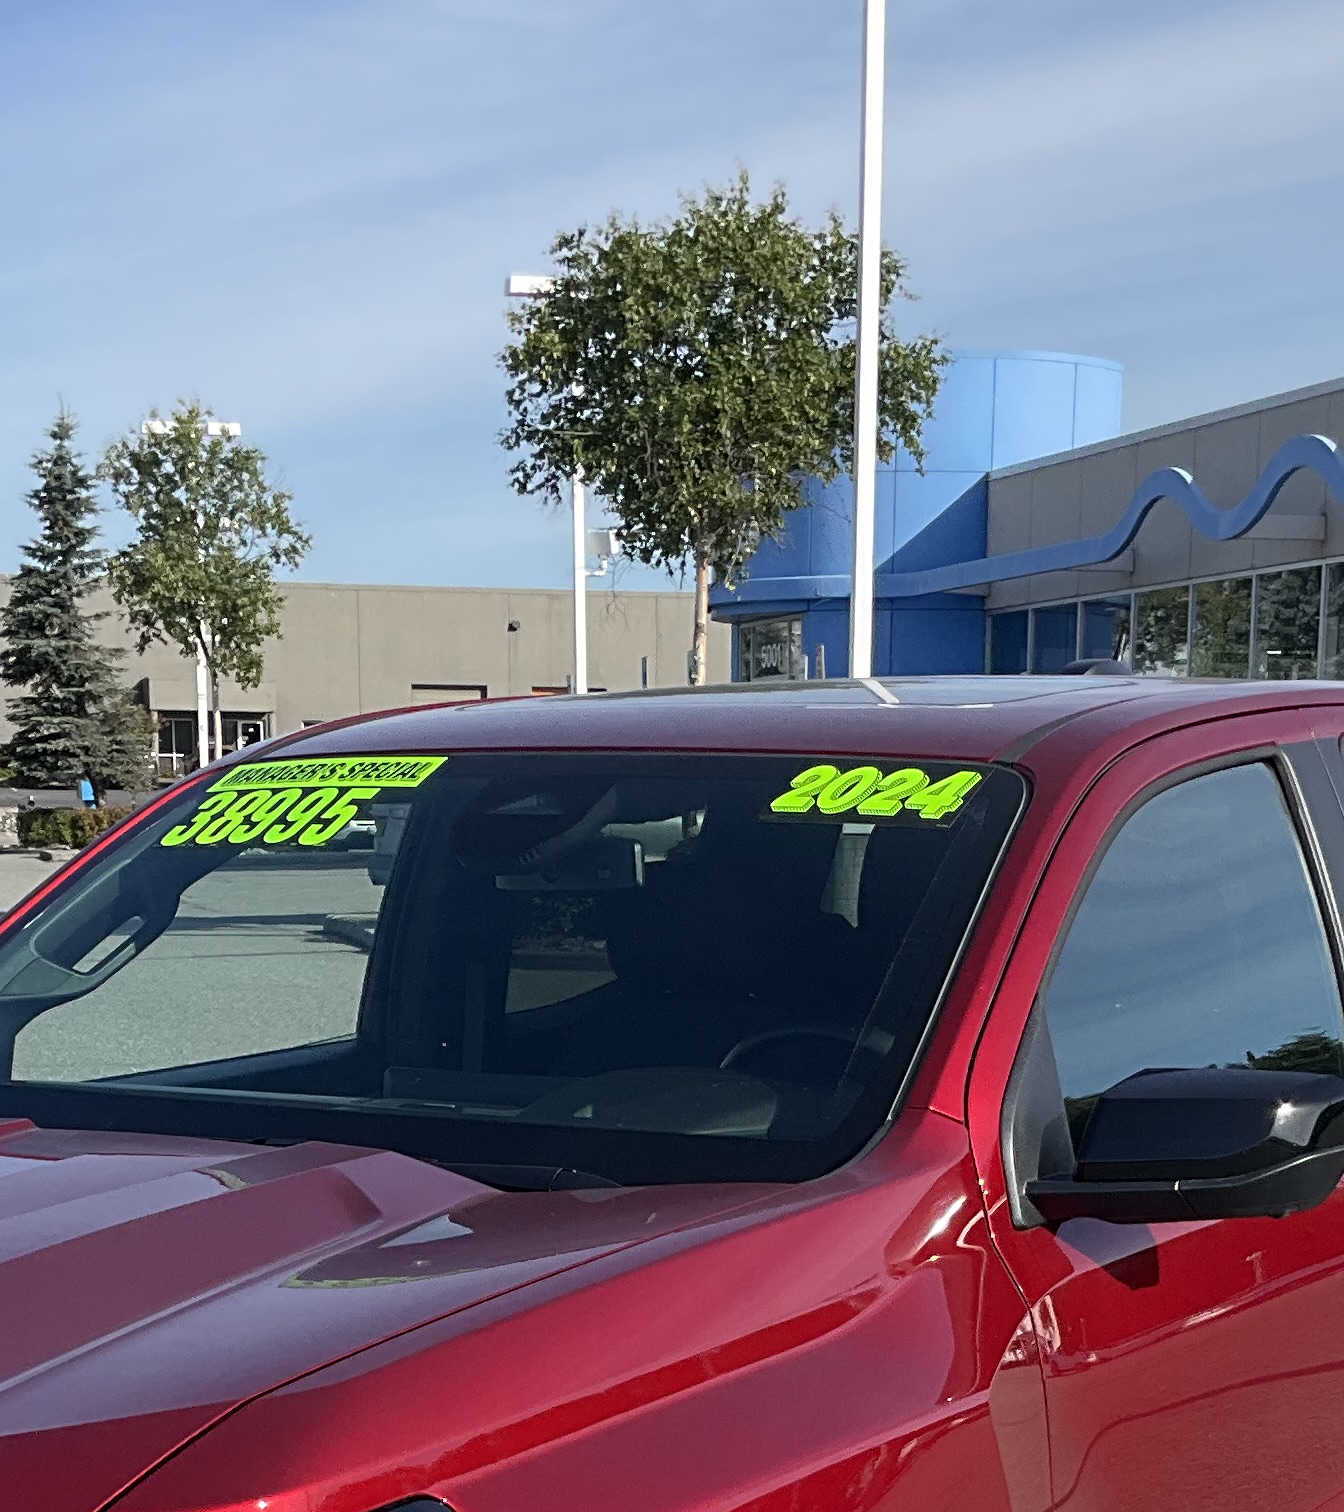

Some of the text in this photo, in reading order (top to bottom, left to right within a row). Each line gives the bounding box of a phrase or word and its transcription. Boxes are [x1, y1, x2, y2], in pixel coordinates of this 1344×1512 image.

[225, 761, 433, 786] MANAGER'S SPECIAL
[770, 764, 983, 819] 2024
[160, 787, 382, 847] 38995
